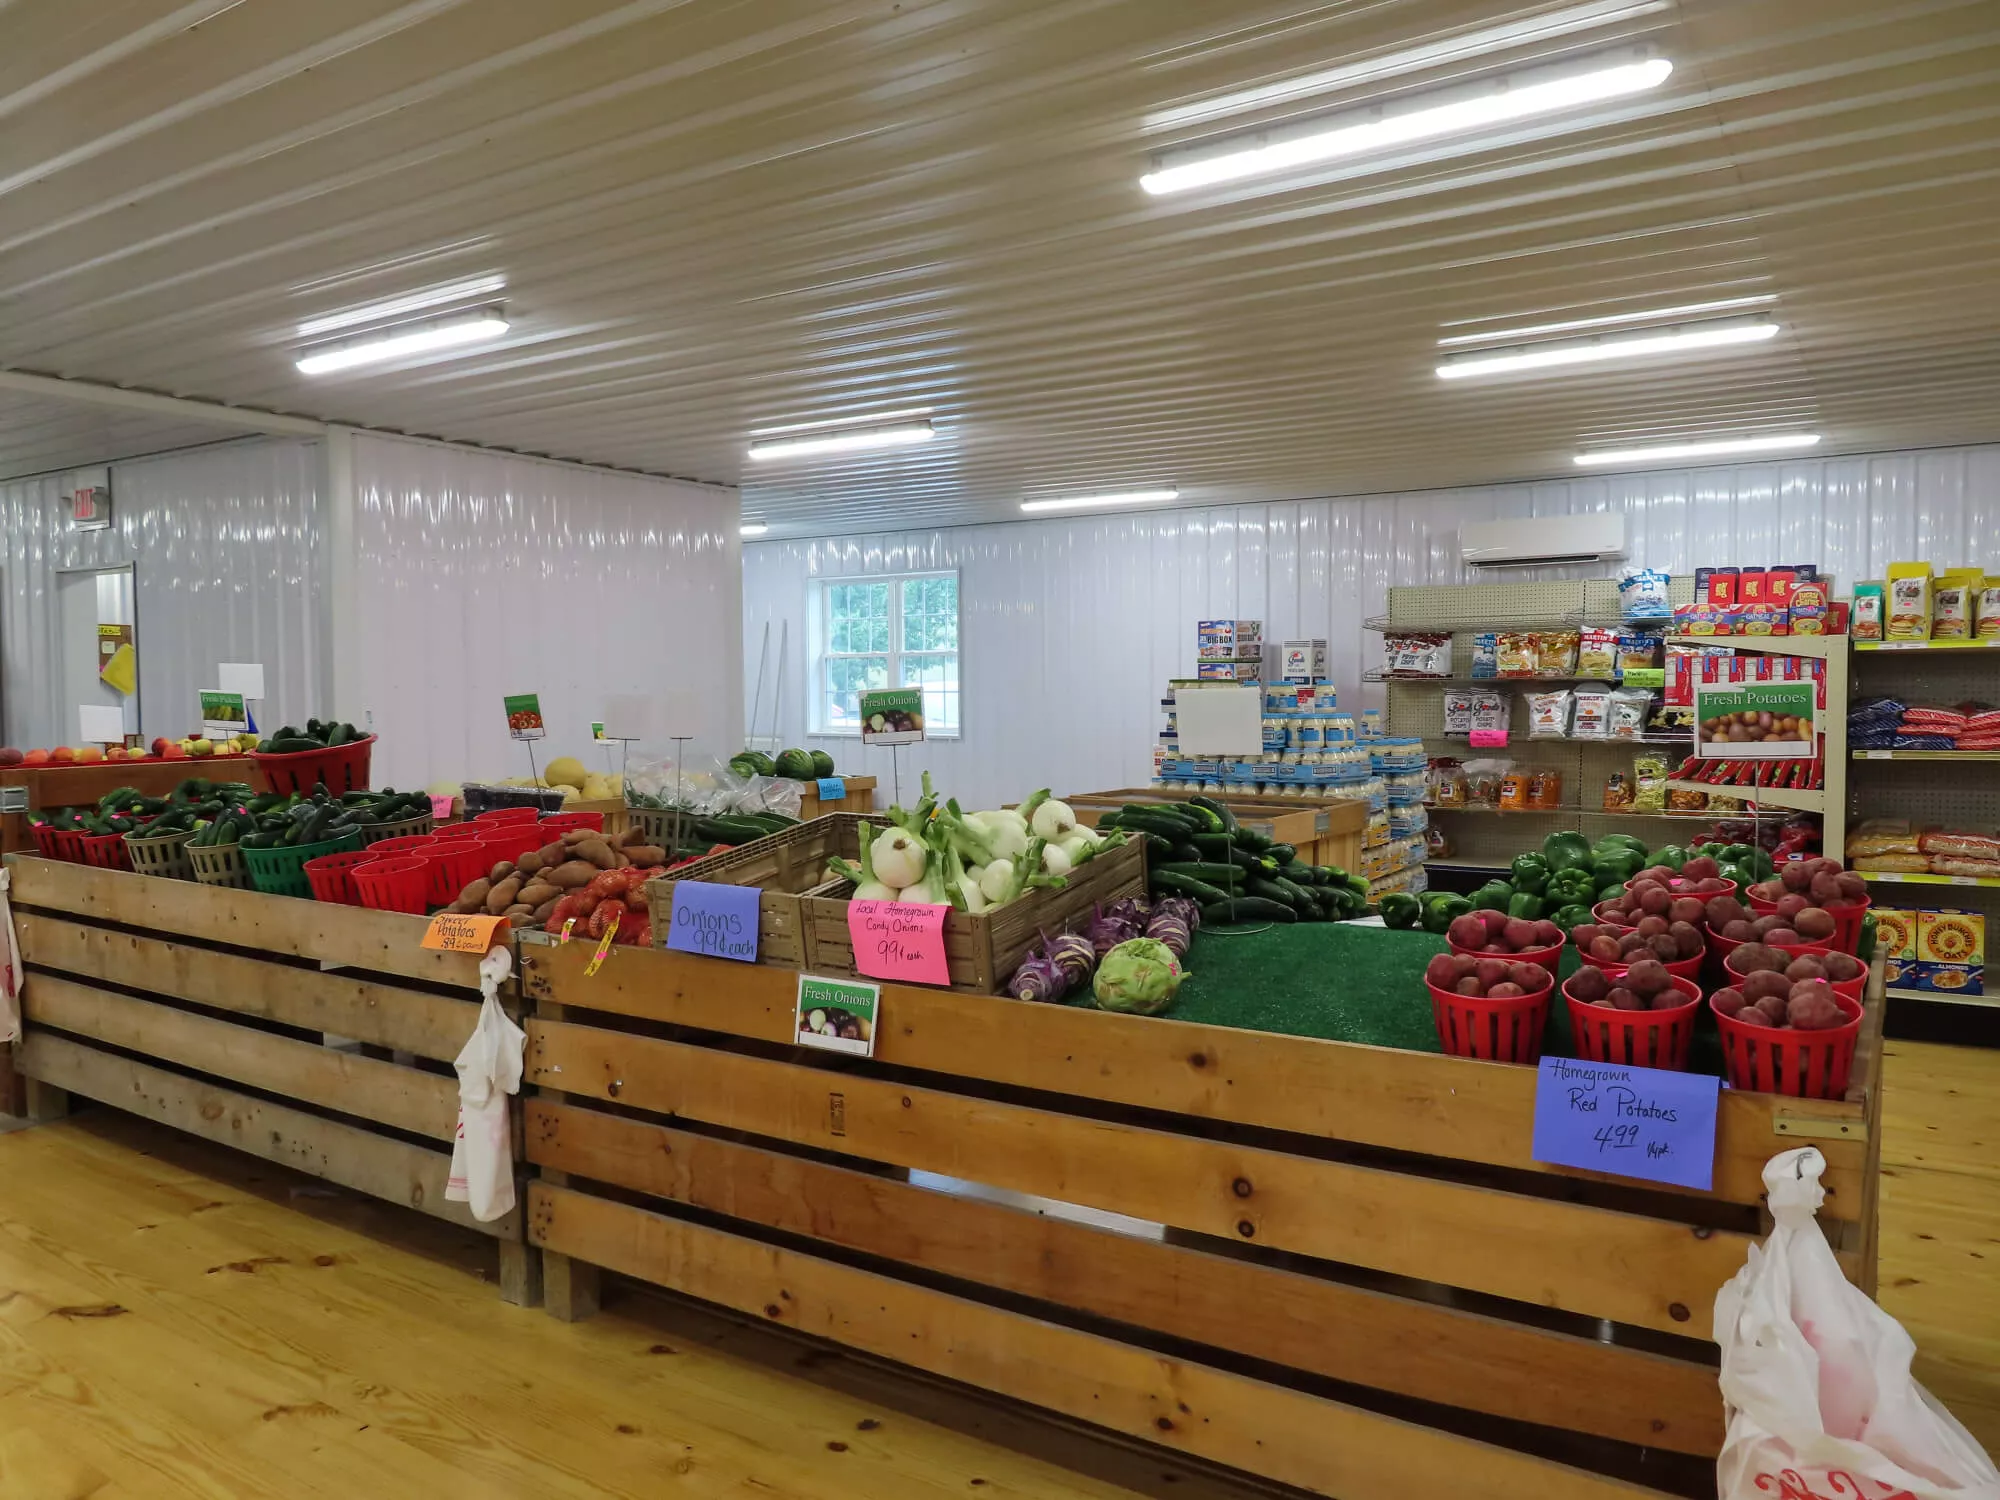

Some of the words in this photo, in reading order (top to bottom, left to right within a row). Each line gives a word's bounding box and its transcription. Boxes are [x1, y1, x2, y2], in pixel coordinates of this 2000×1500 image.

[74, 488, 94, 519] EXIT
[863, 698, 886, 708] Fresh
[888, 694, 918, 706] Onions
[1703, 693, 1742, 705] Fresh
[1747, 692, 1807, 705] Potatoes
[678, 905, 743, 935] Onions
[884, 902, 935, 922] Homegrown
[436, 923, 477, 938] Potatoes
[866, 917, 890, 937] Candy
[728, 940, 754, 955] each
[805, 986, 832, 1001] Fresh
[834, 990, 871, 1007] Onions
[1548, 1058, 1632, 1091] Homegrown
[1567, 1087, 1598, 1112] Red
[1606, 1086, 1678, 1122] Potatoes
